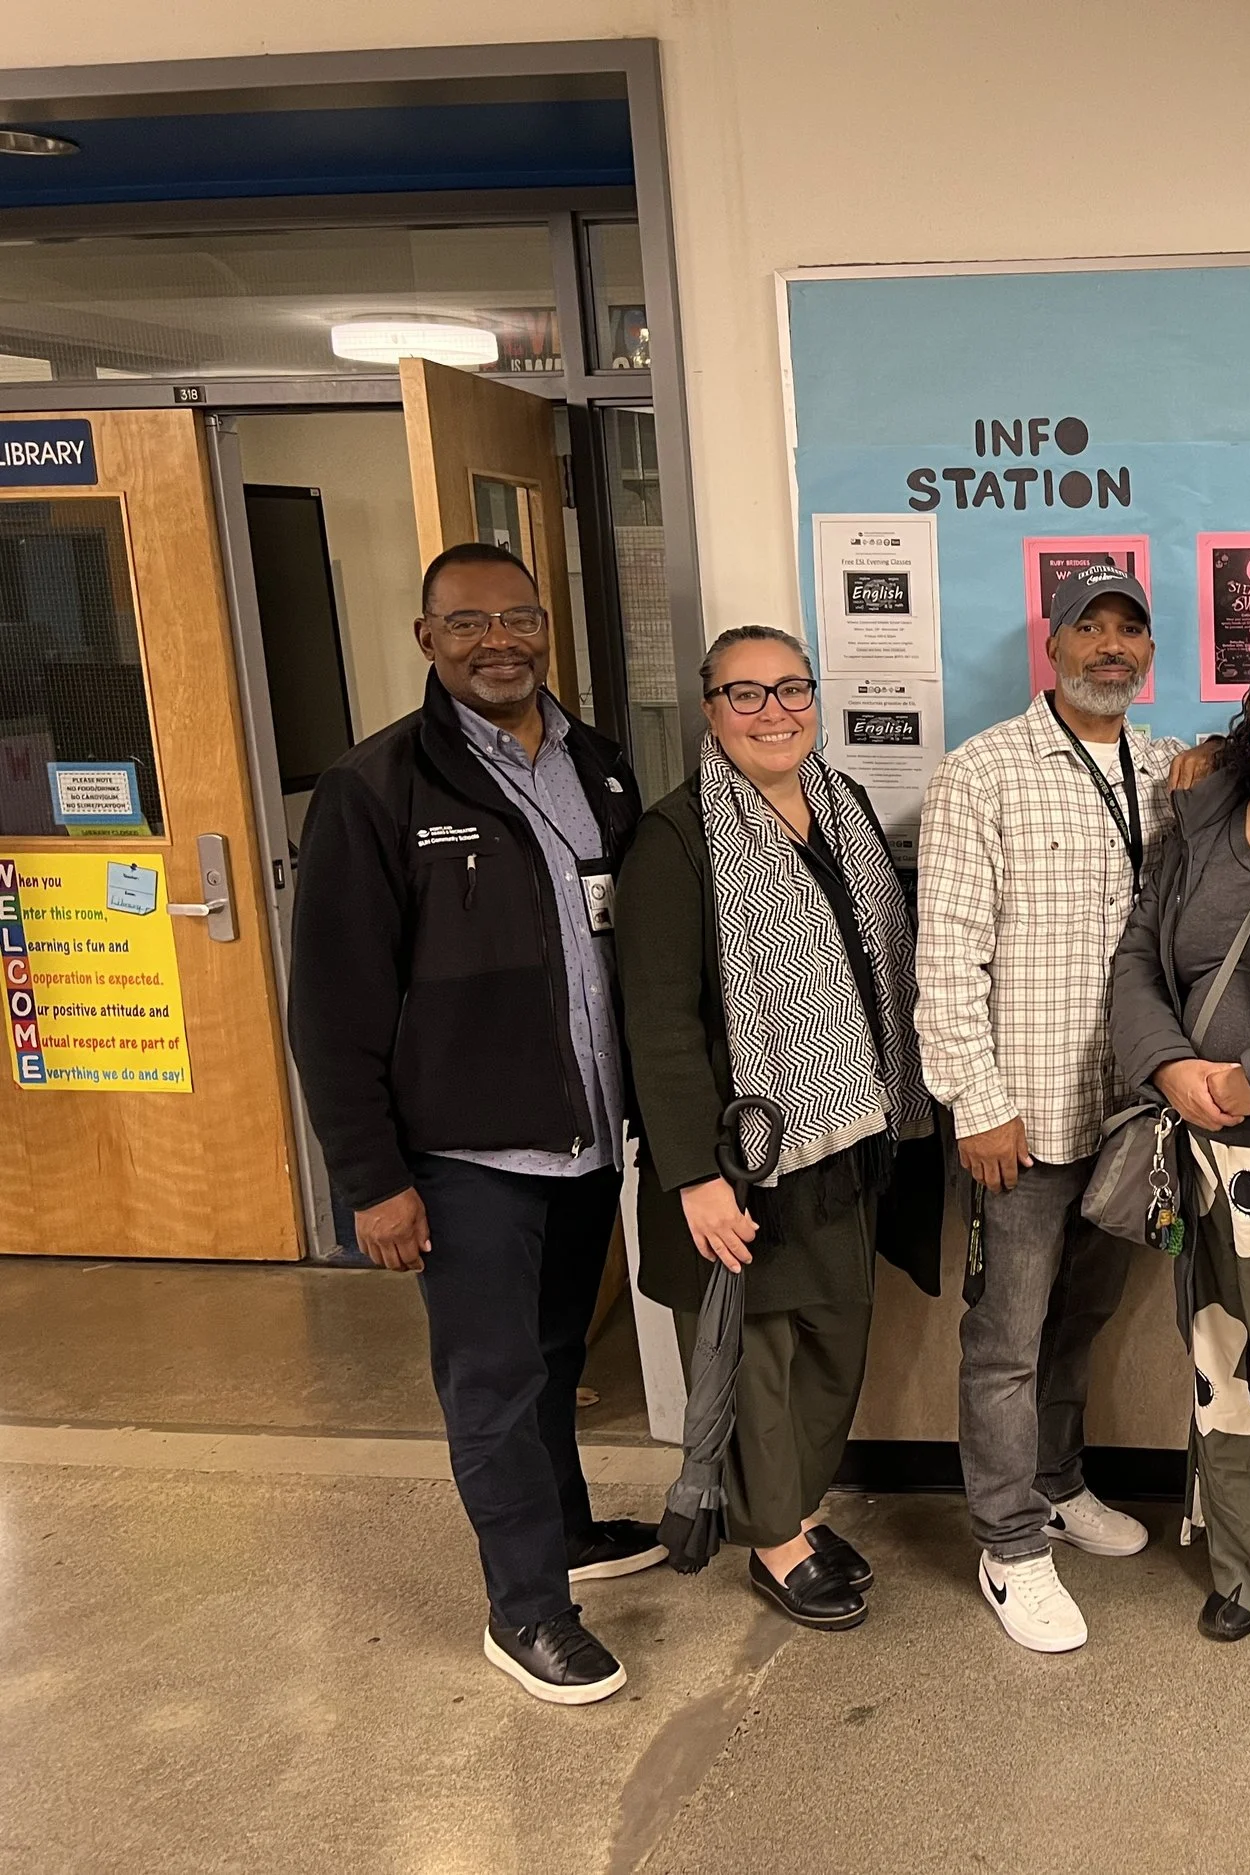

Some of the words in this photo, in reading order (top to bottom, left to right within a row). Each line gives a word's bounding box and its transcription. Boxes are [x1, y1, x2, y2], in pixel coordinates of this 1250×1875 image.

[180, 389, 198, 400] 318
[975, 416, 1089, 457] INFO
[906, 466, 1131, 512] STATION
[852, 586, 904, 603] English
[854, 722, 913, 736] English
[43, 877, 62, 890] you
[50, 905, 72, 920] this
[75, 910, 108, 922] room,
[73, 939, 83, 952] is
[86, 938, 105, 953] fun
[109, 939, 129, 953] and
[96, 971, 105, 984] is
[108, 973, 164, 989] expected.
[53, 1003, 97, 1020] positive
[100, 1004, 146, 1018] attitude
[150, 1005, 169, 1018] and
[73, 1037, 116, 1052] respect
[120, 1038, 138, 1049] are
[141, 1037, 165, 1053] part
[169, 1037, 180, 1049] of
[103, 1070, 118, 1080] we
[122, 1068, 135, 1080] do
[139, 1068, 159, 1081] and
[162, 1068, 185, 1084] say!
